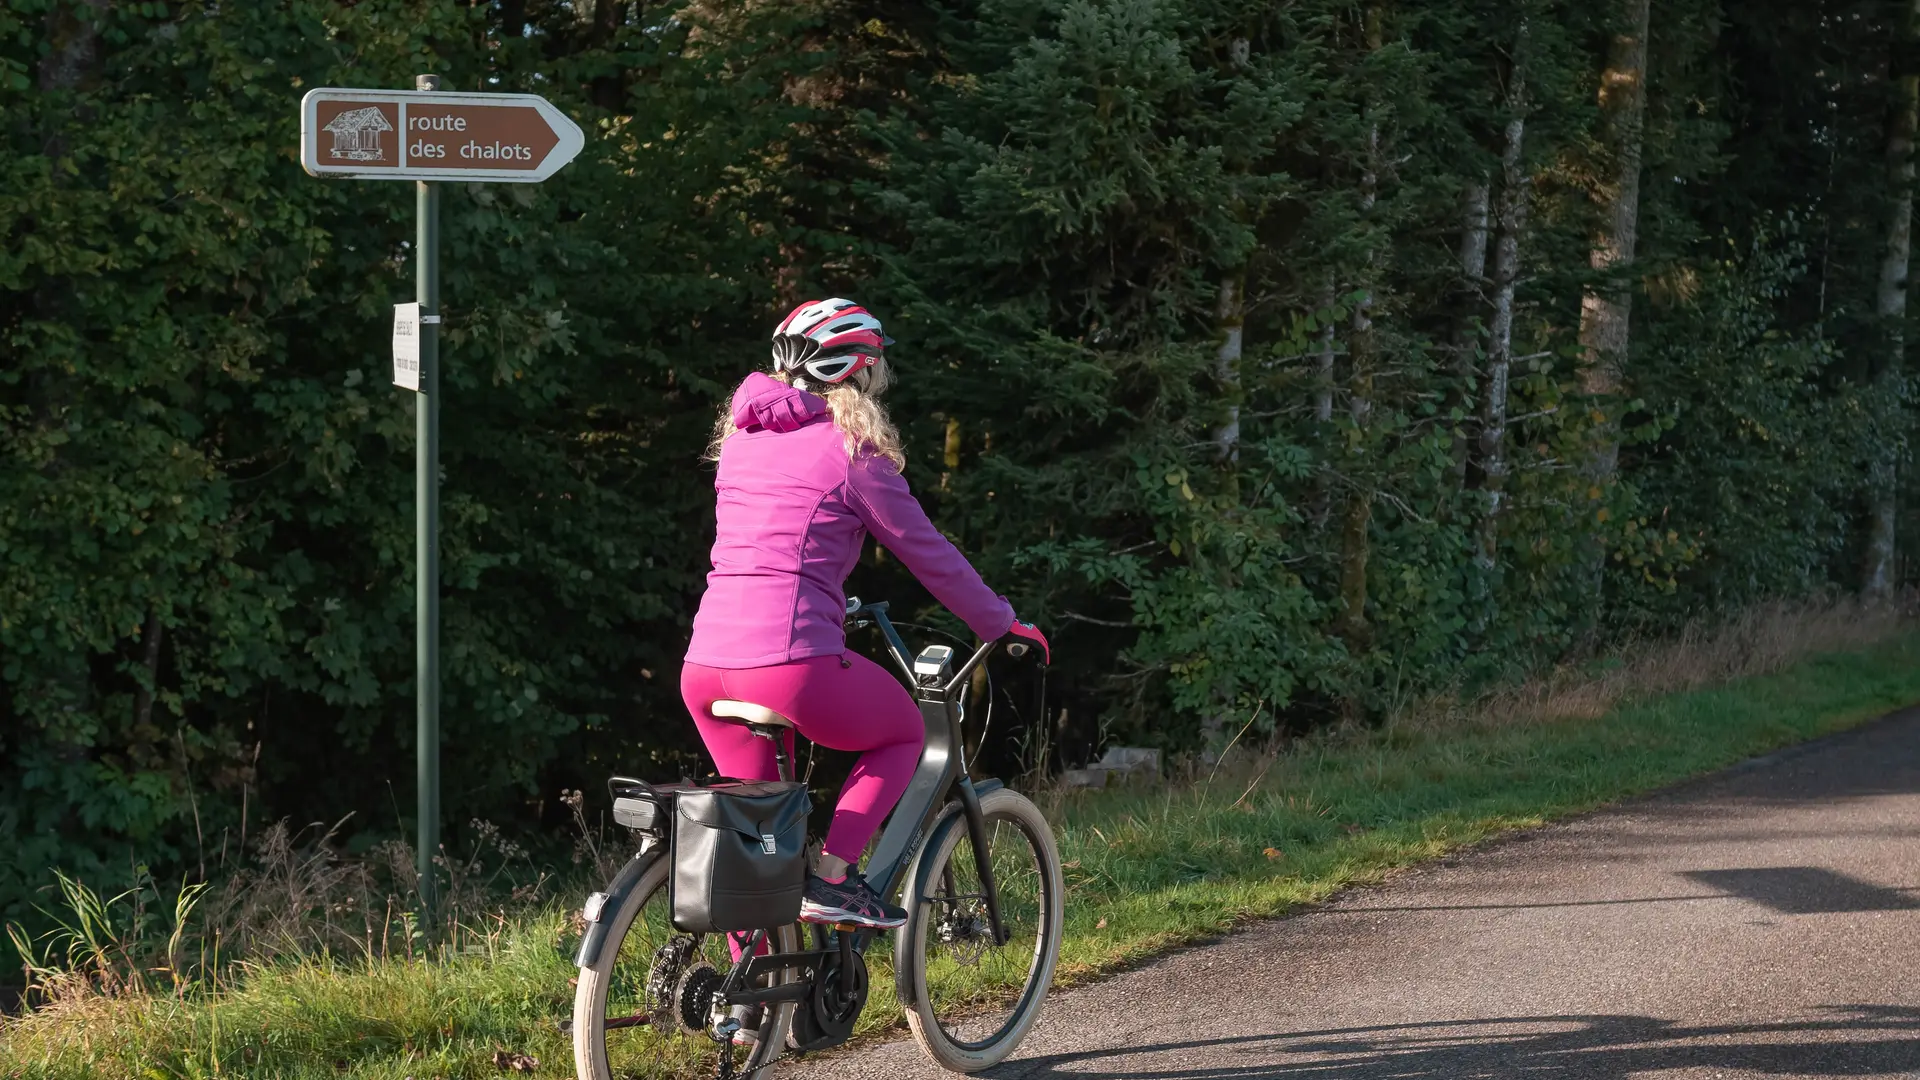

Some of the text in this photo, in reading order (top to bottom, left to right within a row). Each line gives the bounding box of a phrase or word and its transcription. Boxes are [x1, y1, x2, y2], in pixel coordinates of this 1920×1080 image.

[409, 114, 467, 132] route
[409, 138, 532, 161] des chalots
